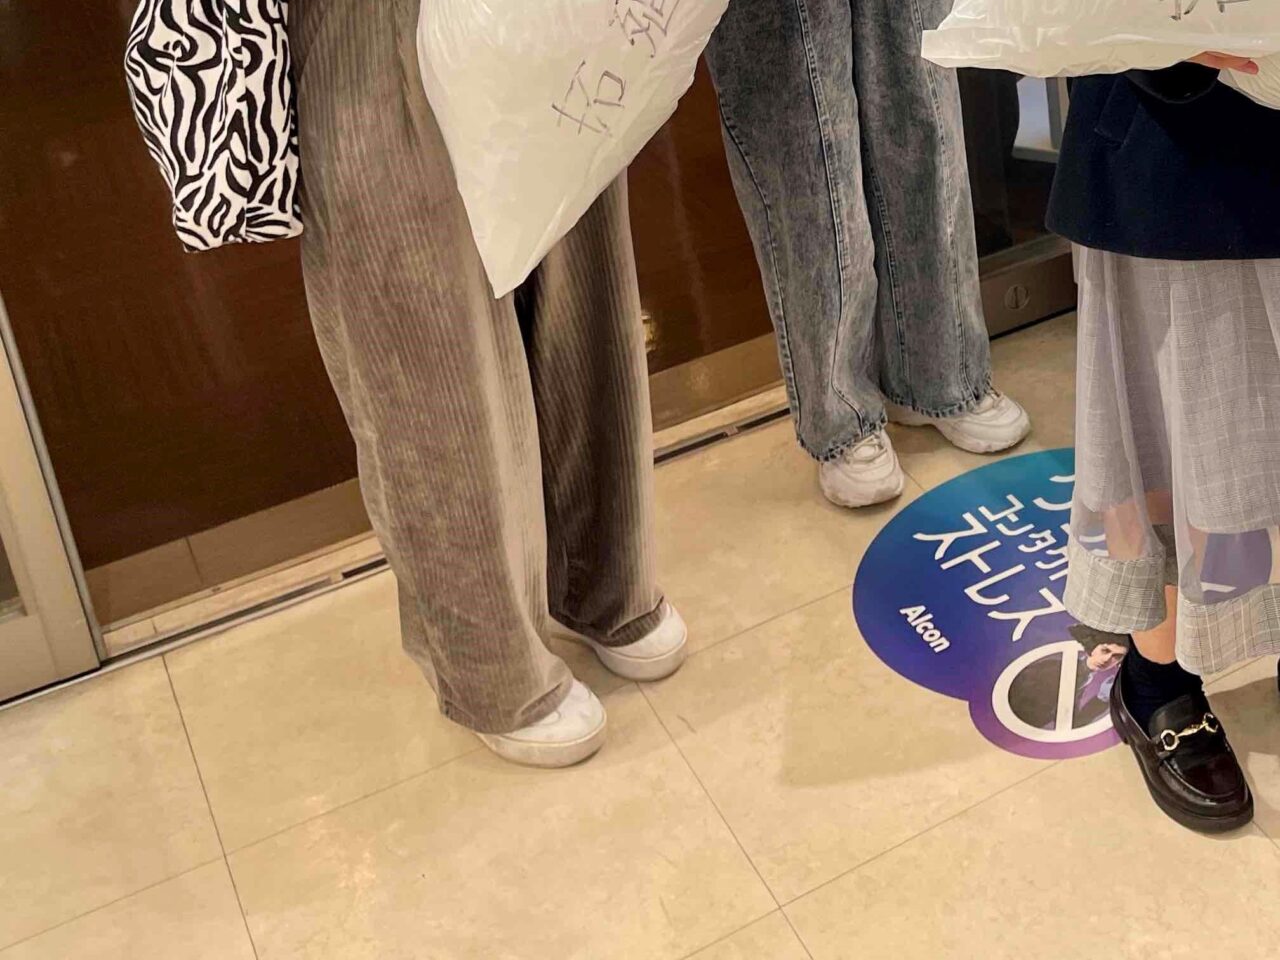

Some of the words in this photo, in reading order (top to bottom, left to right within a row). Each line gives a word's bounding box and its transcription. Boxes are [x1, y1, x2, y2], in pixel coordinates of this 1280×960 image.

[912, 512, 1067, 642] ストレス
[899, 605, 952, 653] Alcon
